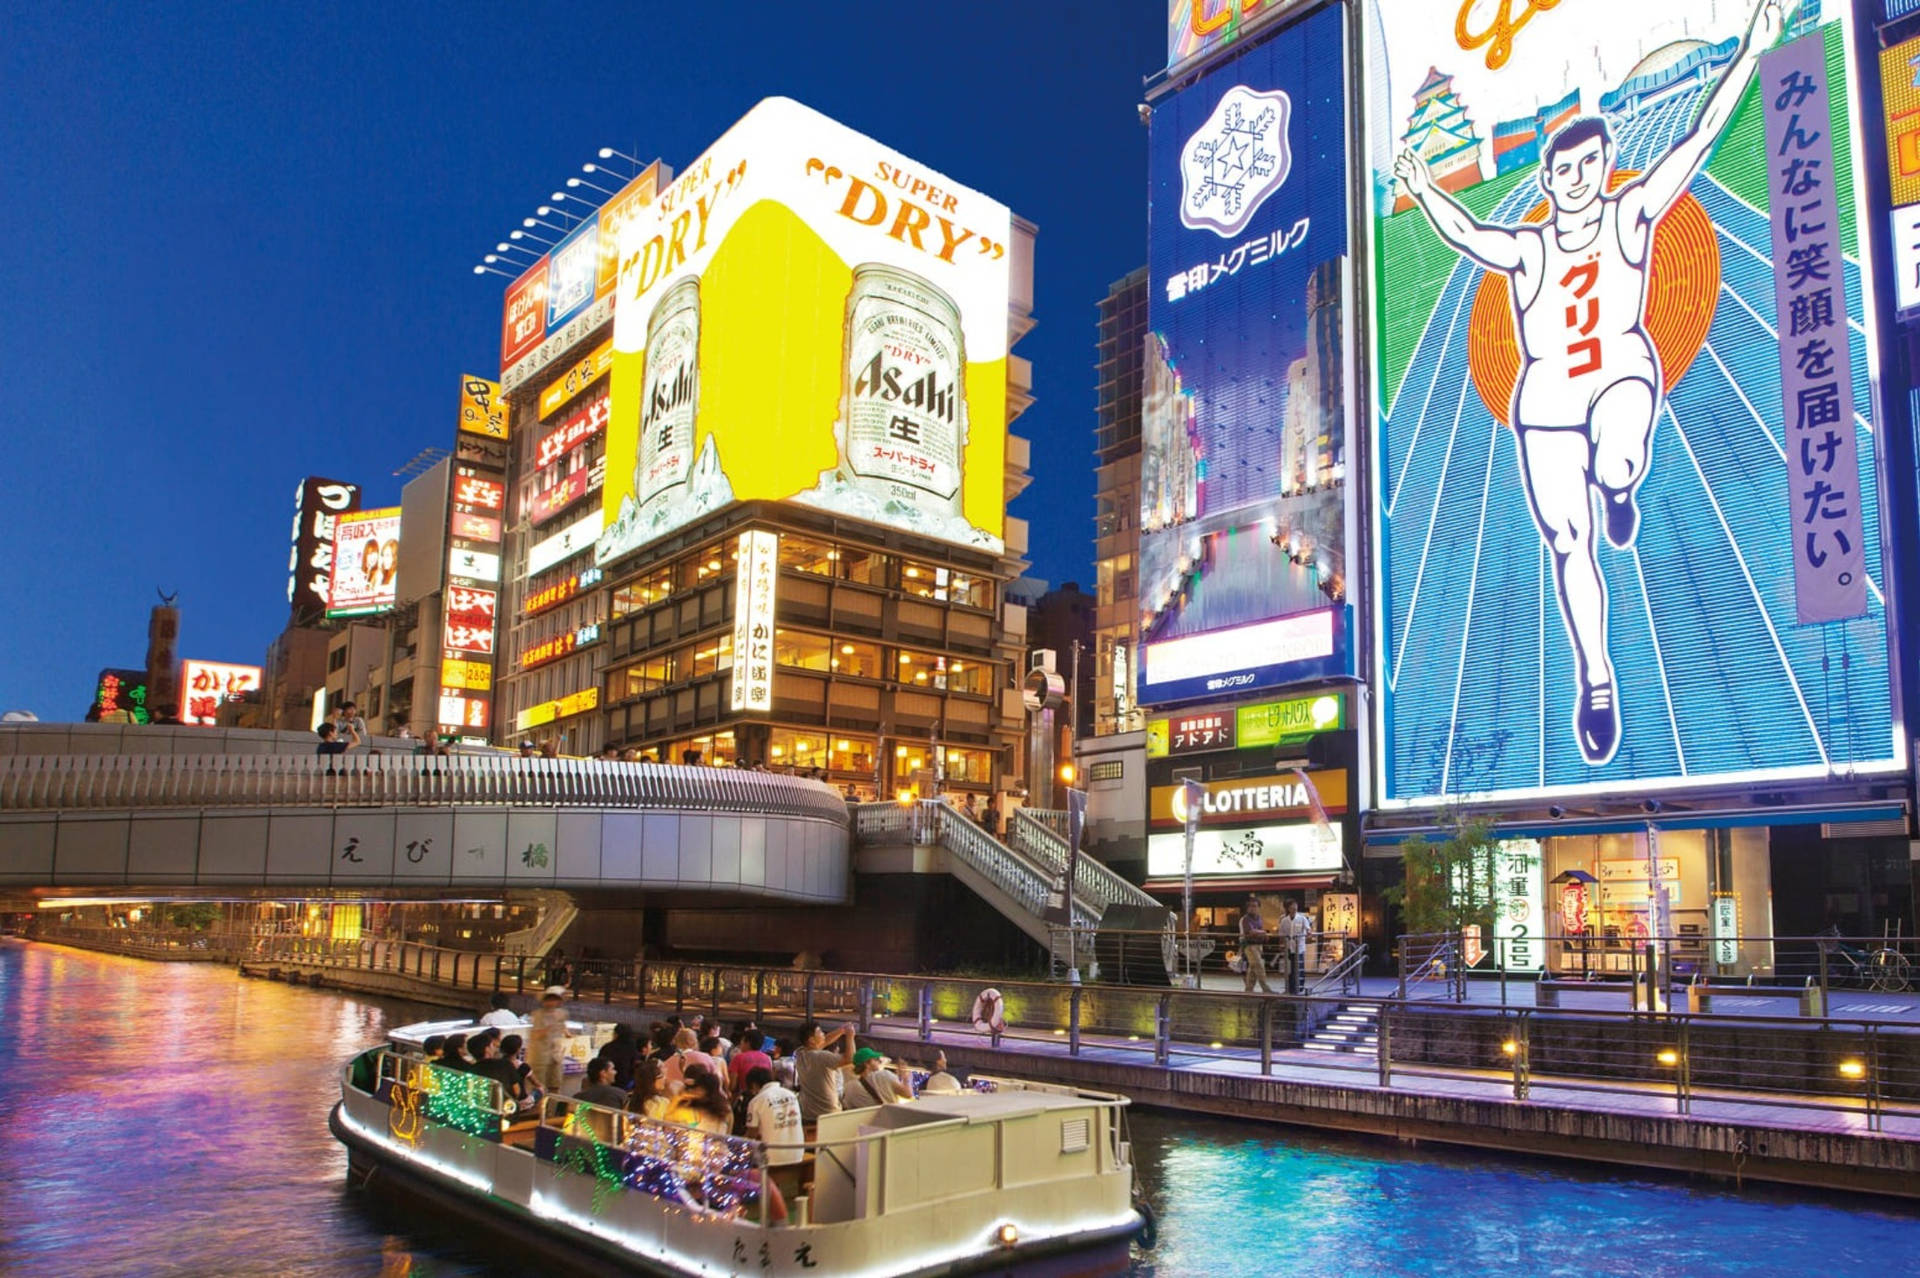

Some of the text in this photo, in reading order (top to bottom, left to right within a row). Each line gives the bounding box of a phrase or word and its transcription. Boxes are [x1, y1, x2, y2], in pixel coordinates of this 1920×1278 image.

[873, 160, 959, 215] SUPER
[1166, 217, 1310, 303] 雪印メグミルク
[1560, 252, 1602, 378] グリコ
[1774, 71, 1852, 586] みんなに笑顔を届けたい。
[643, 360, 694, 434] Asahi
[855, 351, 954, 424] Asahi
[658, 424, 673, 452] 生
[889, 415, 920, 445] 生
[873, 447, 936, 473] スーパードライ
[192, 669, 252, 695] かに
[1174, 727, 1228, 748] アドアド
[1203, 782, 1311, 813] LOTTERIA
